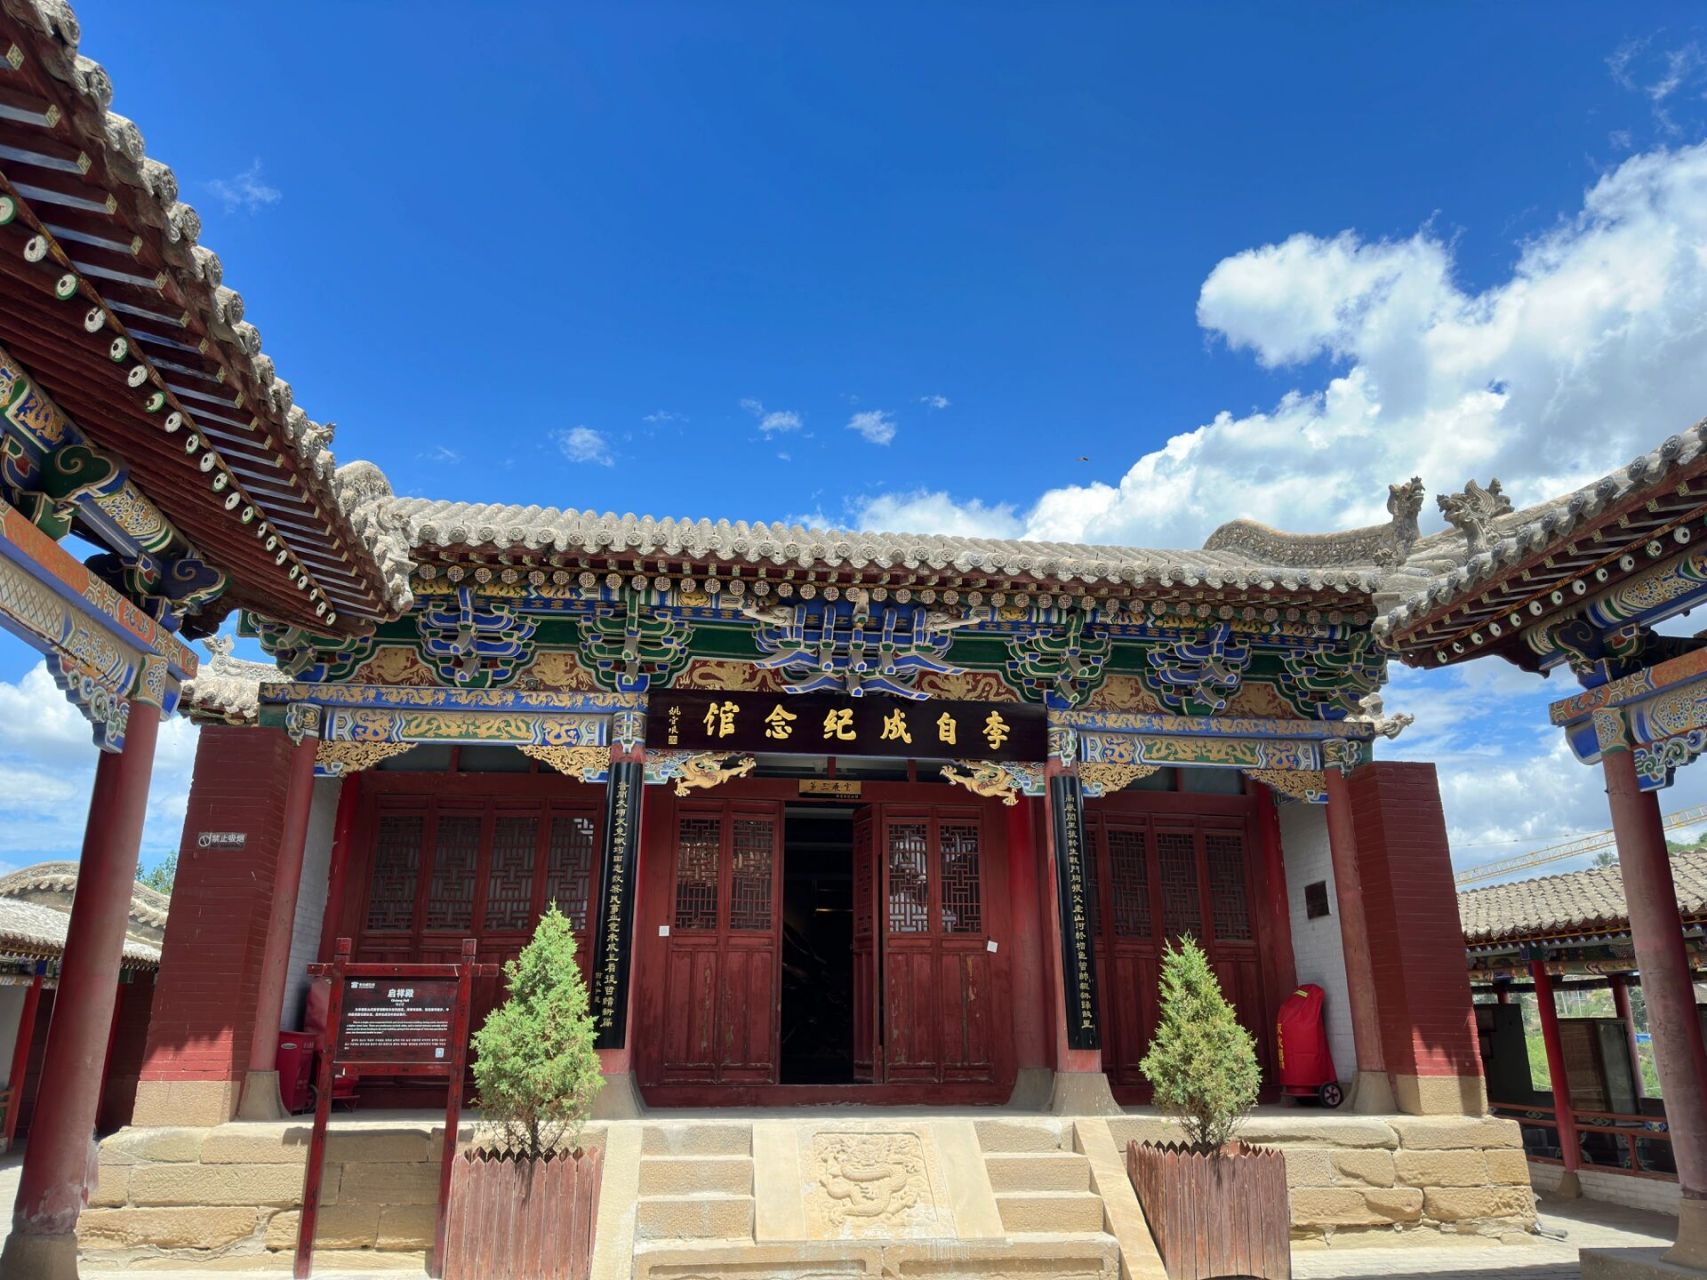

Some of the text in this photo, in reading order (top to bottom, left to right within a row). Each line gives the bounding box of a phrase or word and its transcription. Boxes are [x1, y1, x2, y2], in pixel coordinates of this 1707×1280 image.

[703, 701, 1011, 750] 李自成纪念馆
